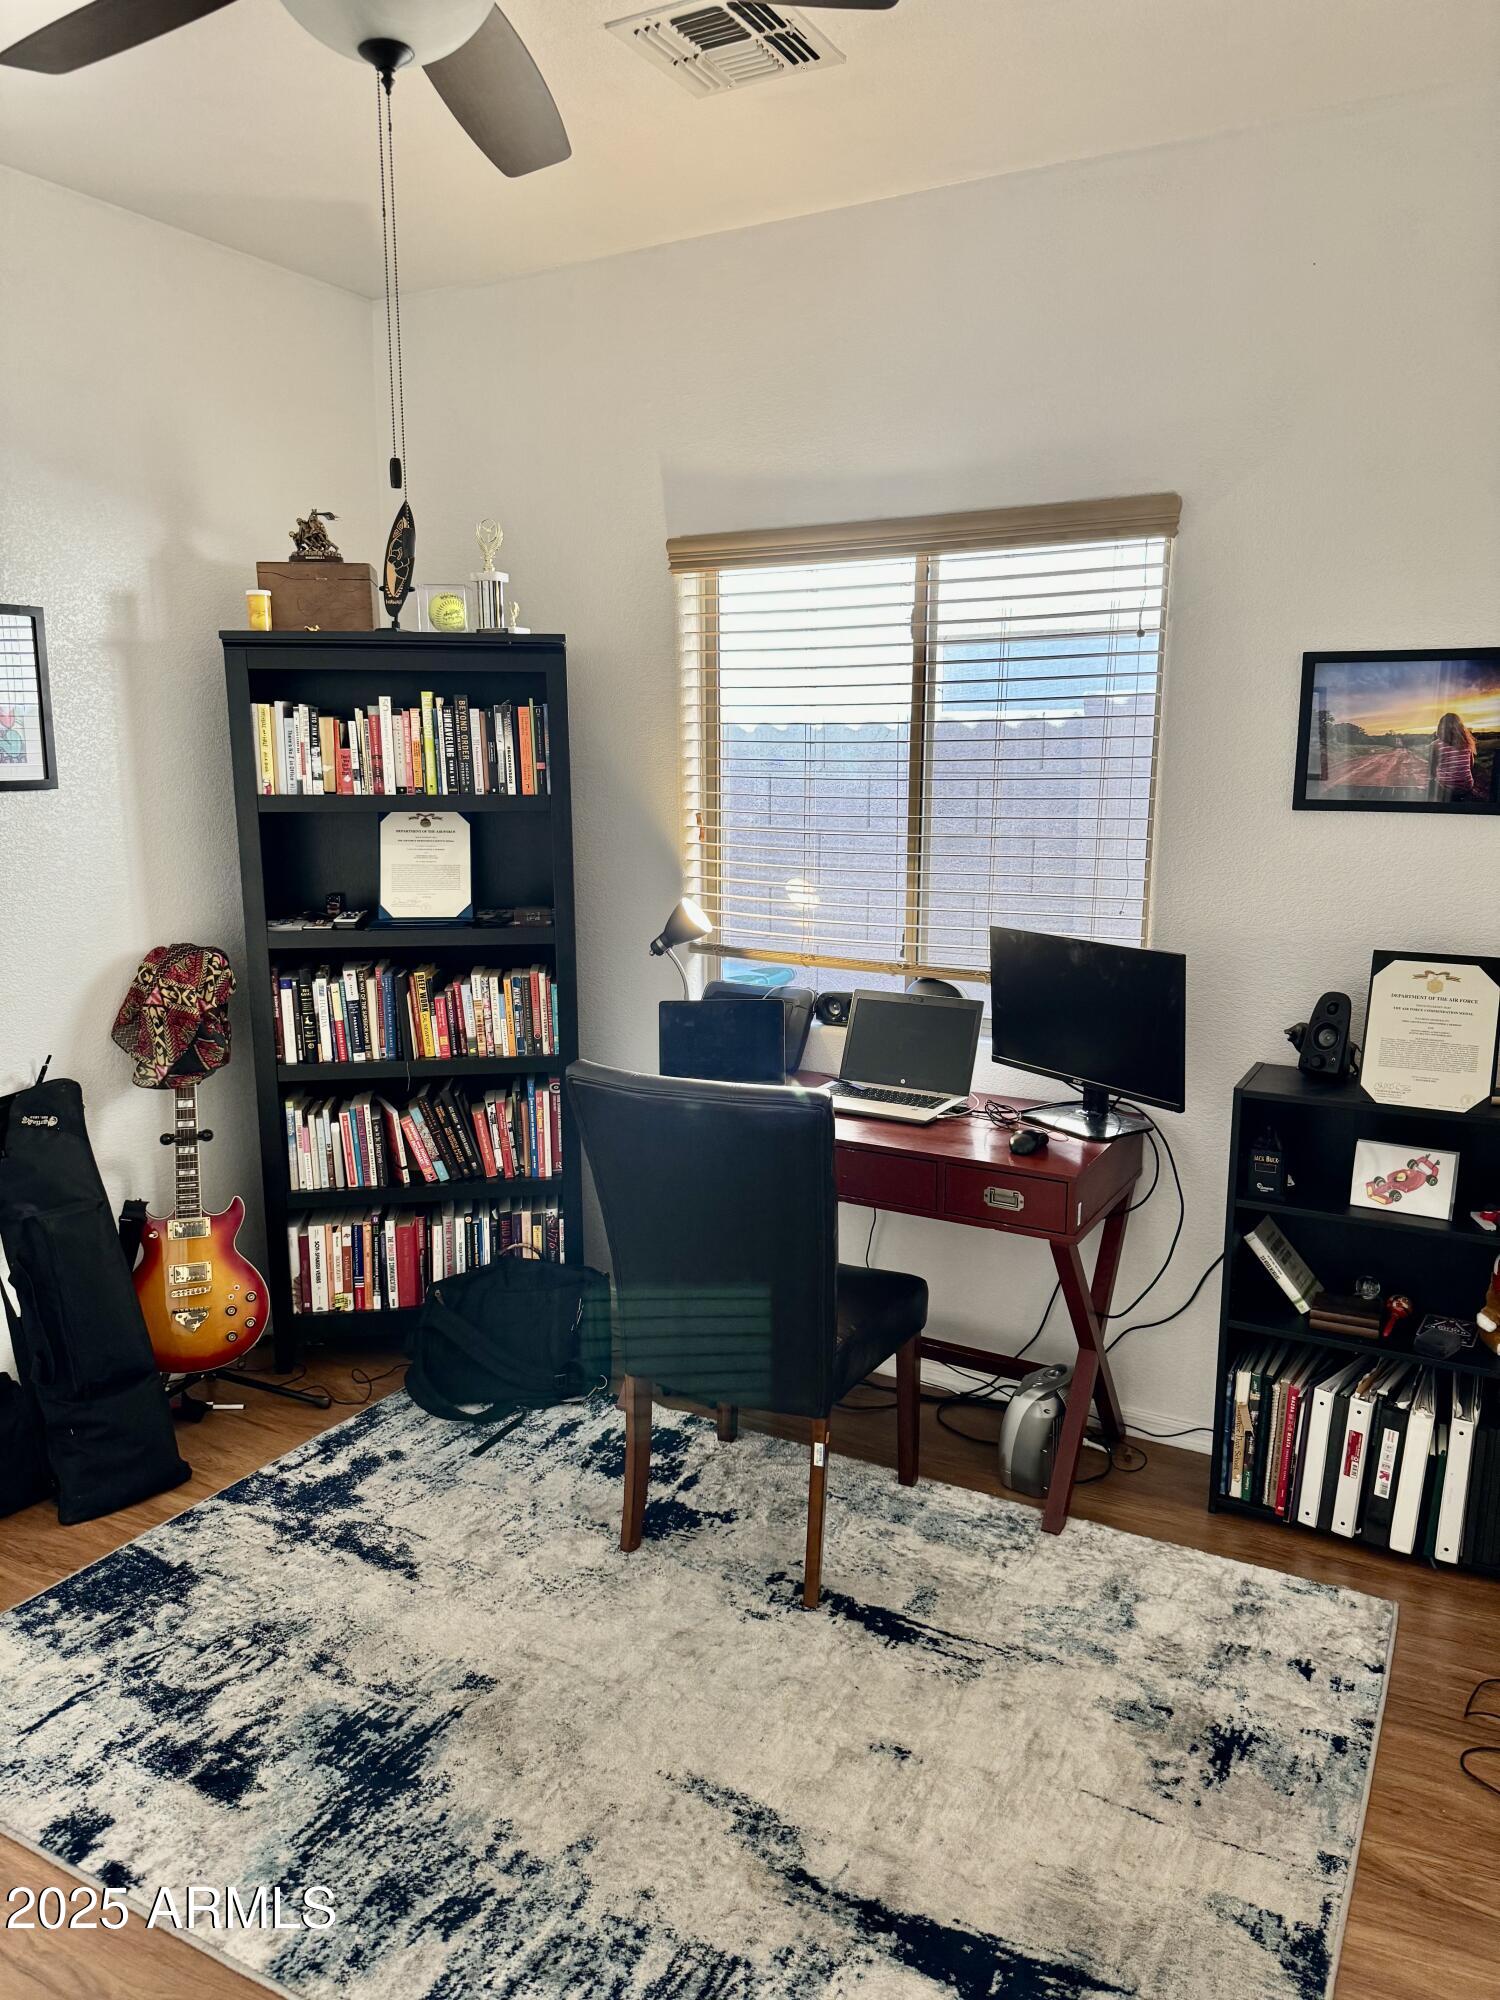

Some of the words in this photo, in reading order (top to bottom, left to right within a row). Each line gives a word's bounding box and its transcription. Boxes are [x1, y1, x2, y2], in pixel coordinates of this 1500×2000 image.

[421, 696, 433, 737] BLINDSPOT
[458, 700, 468, 732] BEYOND
[443, 713, 455, 758] UNRAVELING
[461, 734, 470, 760] ORDER
[361, 993, 367, 1001] OF
[419, 992, 429, 1013] WORK
[410, 1122, 420, 1139] SPANISH
[420, 1148, 430, 1166] ENGLISH
[411, 1140, 424, 1165] DICTIONARY
[1265, 1155, 1280, 1164] BUCK
[547, 1230, 558, 1249] 1776
[388, 1262, 396, 1293] COMMUNICATION
[1233, 1451, 1242, 1470] School
